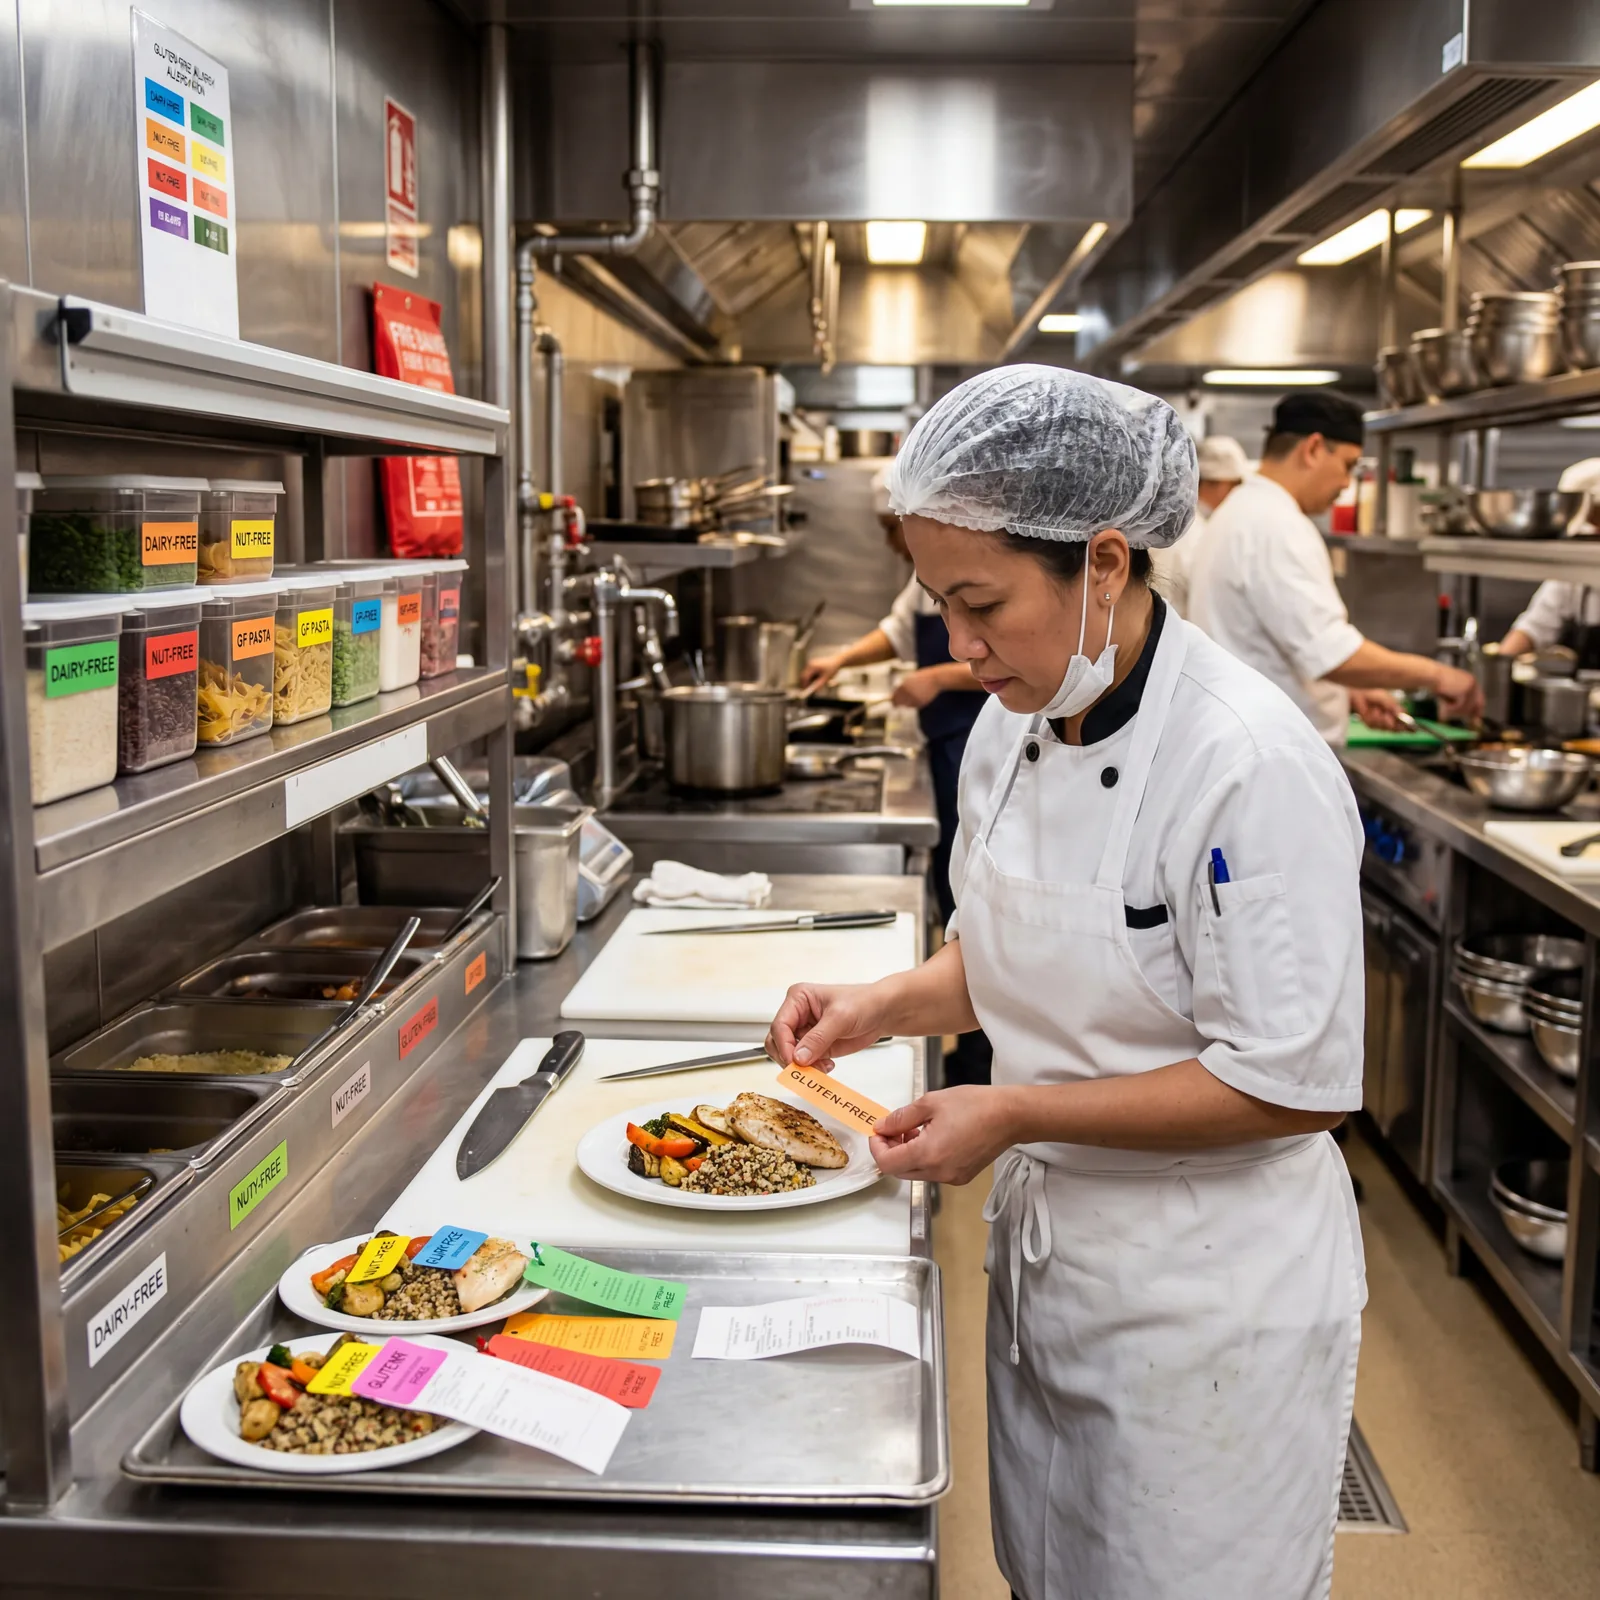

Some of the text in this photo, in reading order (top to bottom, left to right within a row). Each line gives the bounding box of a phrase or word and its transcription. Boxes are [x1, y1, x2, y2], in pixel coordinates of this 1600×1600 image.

[145, 534, 197, 552] DAIRY-FREE
[235, 531, 271, 546] NUT-FREE
[236, 628, 271, 648] GF PASTA
[300, 617, 330, 637] GF PASTA
[151, 643, 194, 666] NUT-FREE
[51, 654, 115, 683] DAIRY-FREE
[335, 1072, 367, 1116] NUT-FREE
[790, 1069, 878, 1127] GLUTEN-FREE
[236, 1156, 282, 1211] NUTY-FREE
[93, 1267, 163, 1349] DAIRY-FREE
